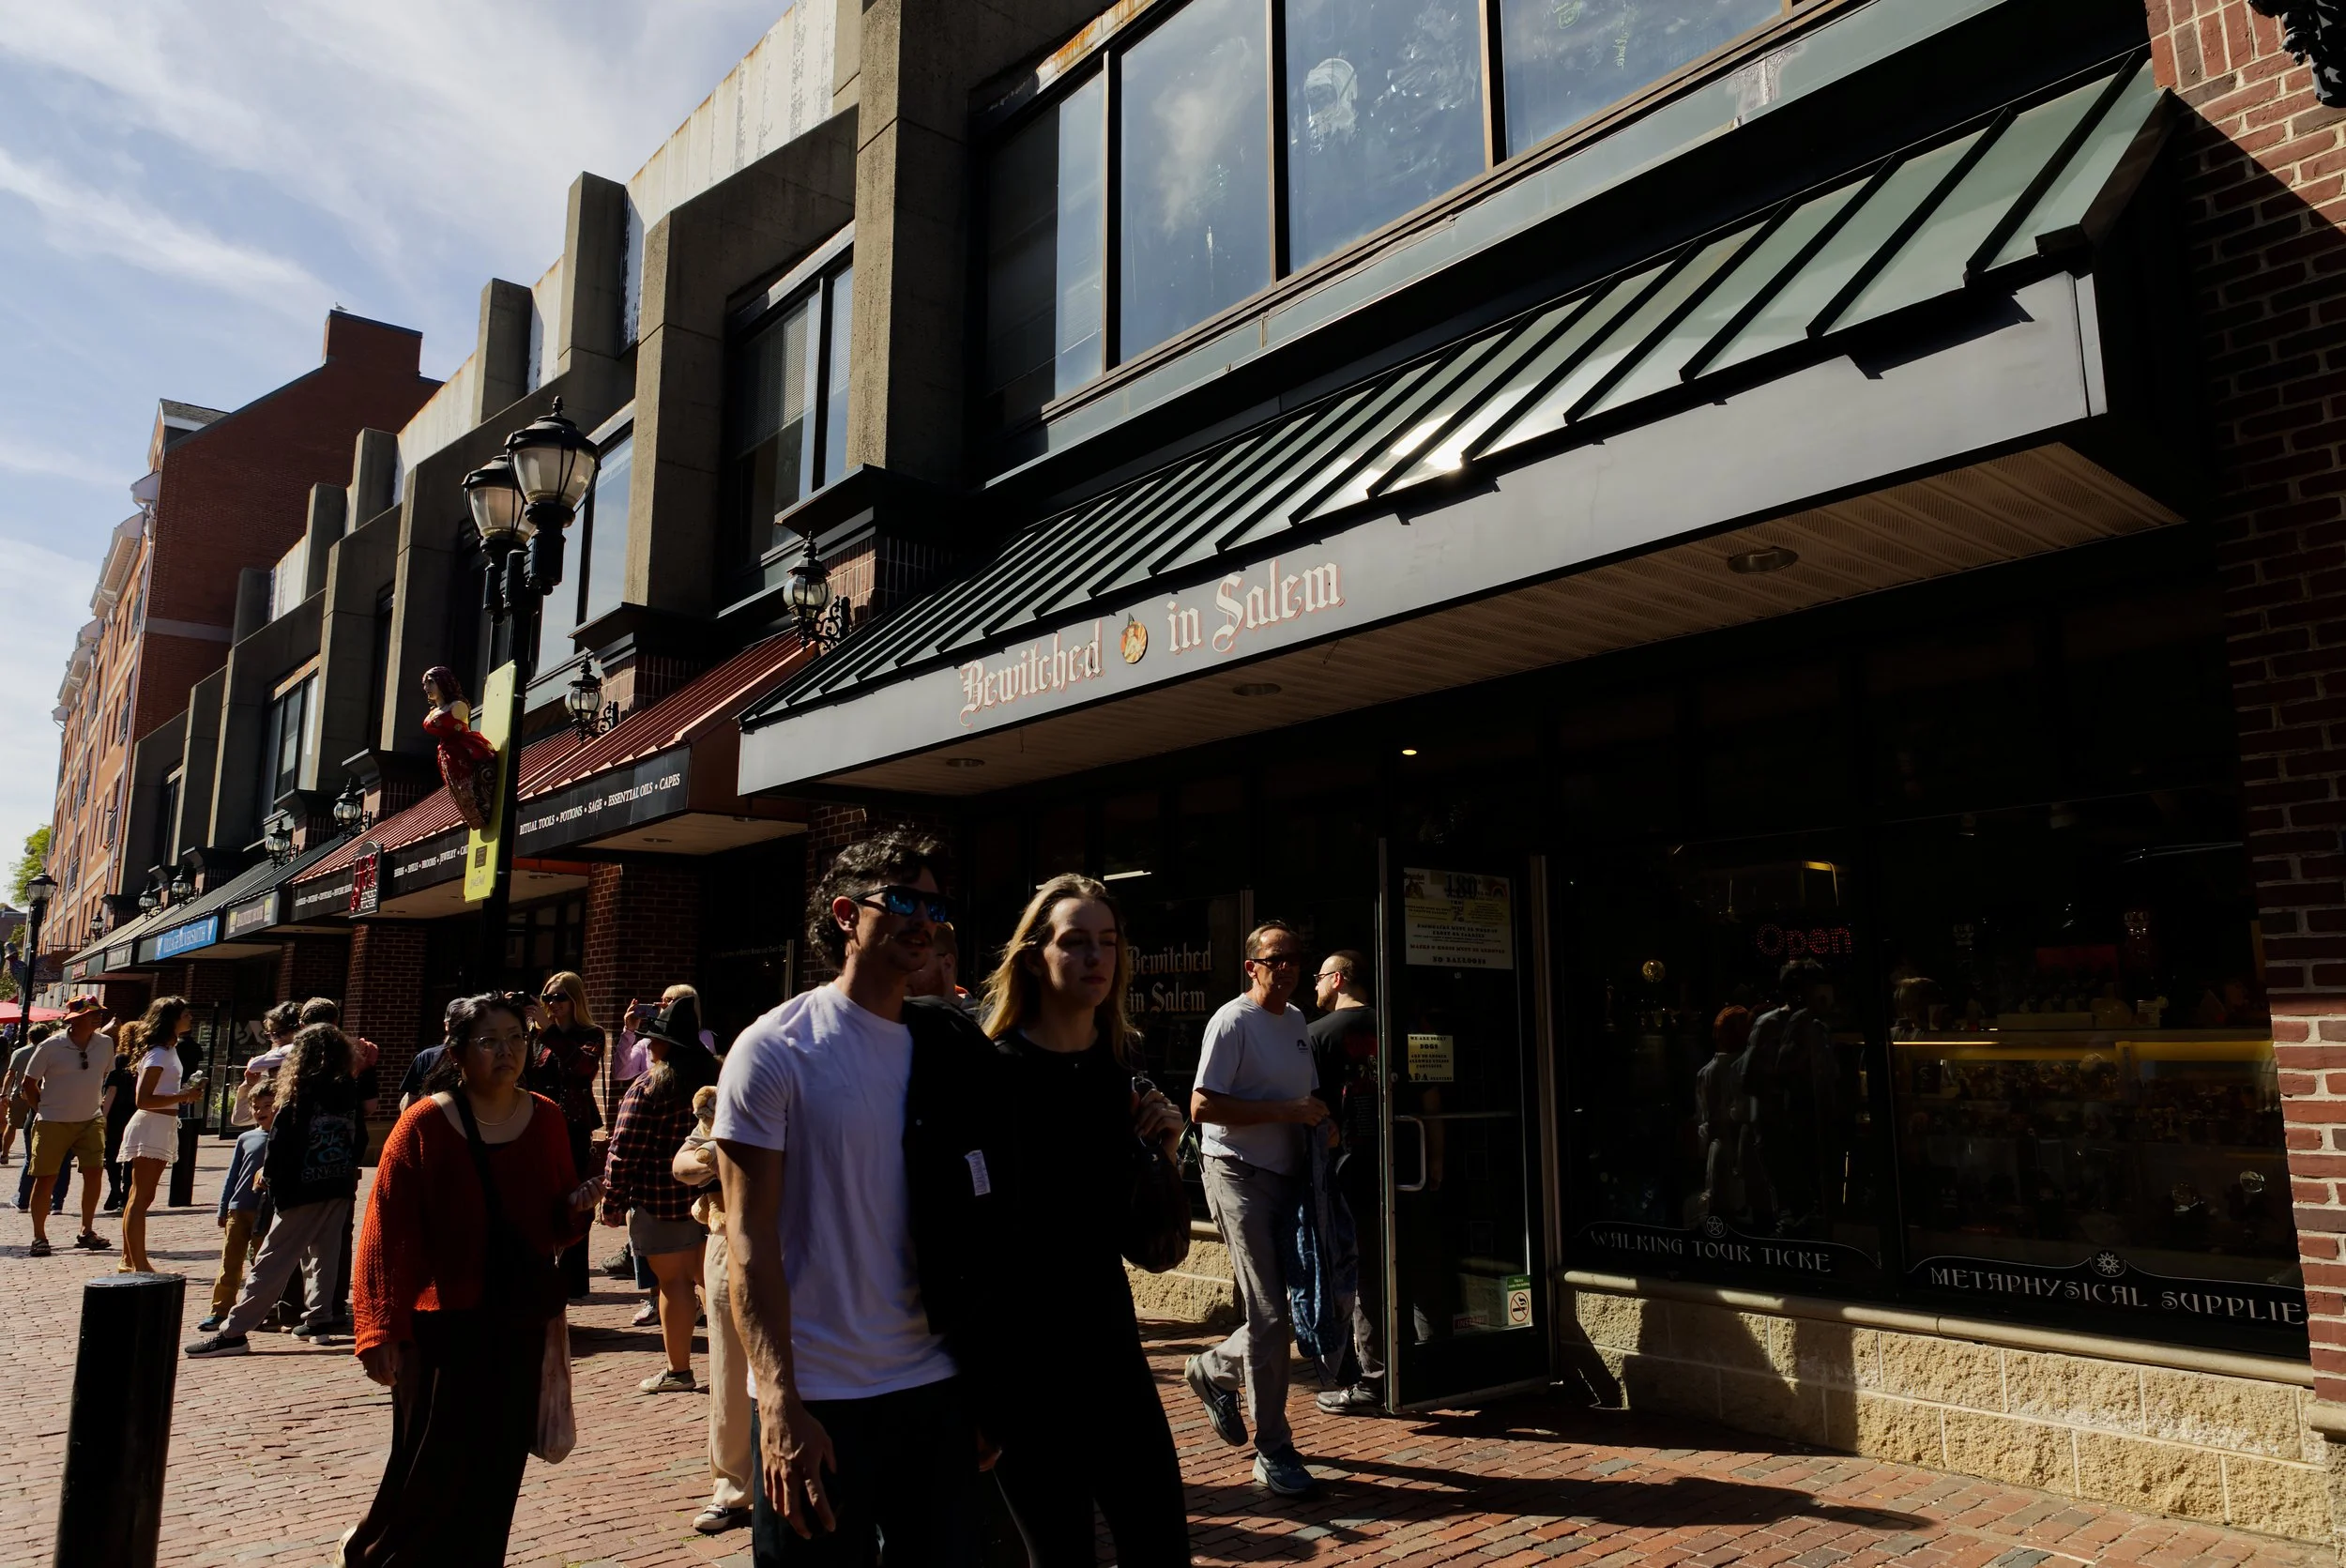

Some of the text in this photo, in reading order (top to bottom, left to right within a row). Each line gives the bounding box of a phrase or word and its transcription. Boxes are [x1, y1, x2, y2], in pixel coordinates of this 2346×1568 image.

[958, 559, 1345, 727] Bewitched in Salem
[519, 773, 680, 835] RITUAL TOOLS POTIONS SAGE ESSENTIAL OILS CAPES
[1126, 939, 1213, 975] Bewitched
[1756, 922, 1853, 960] Open
[1129, 981, 1206, 1014] in Salem
[1588, 1229, 1684, 1258] WALKING
[1690, 1239, 1753, 1267] TOUR
[1929, 1264, 2149, 1308] METAPHYSICAL
